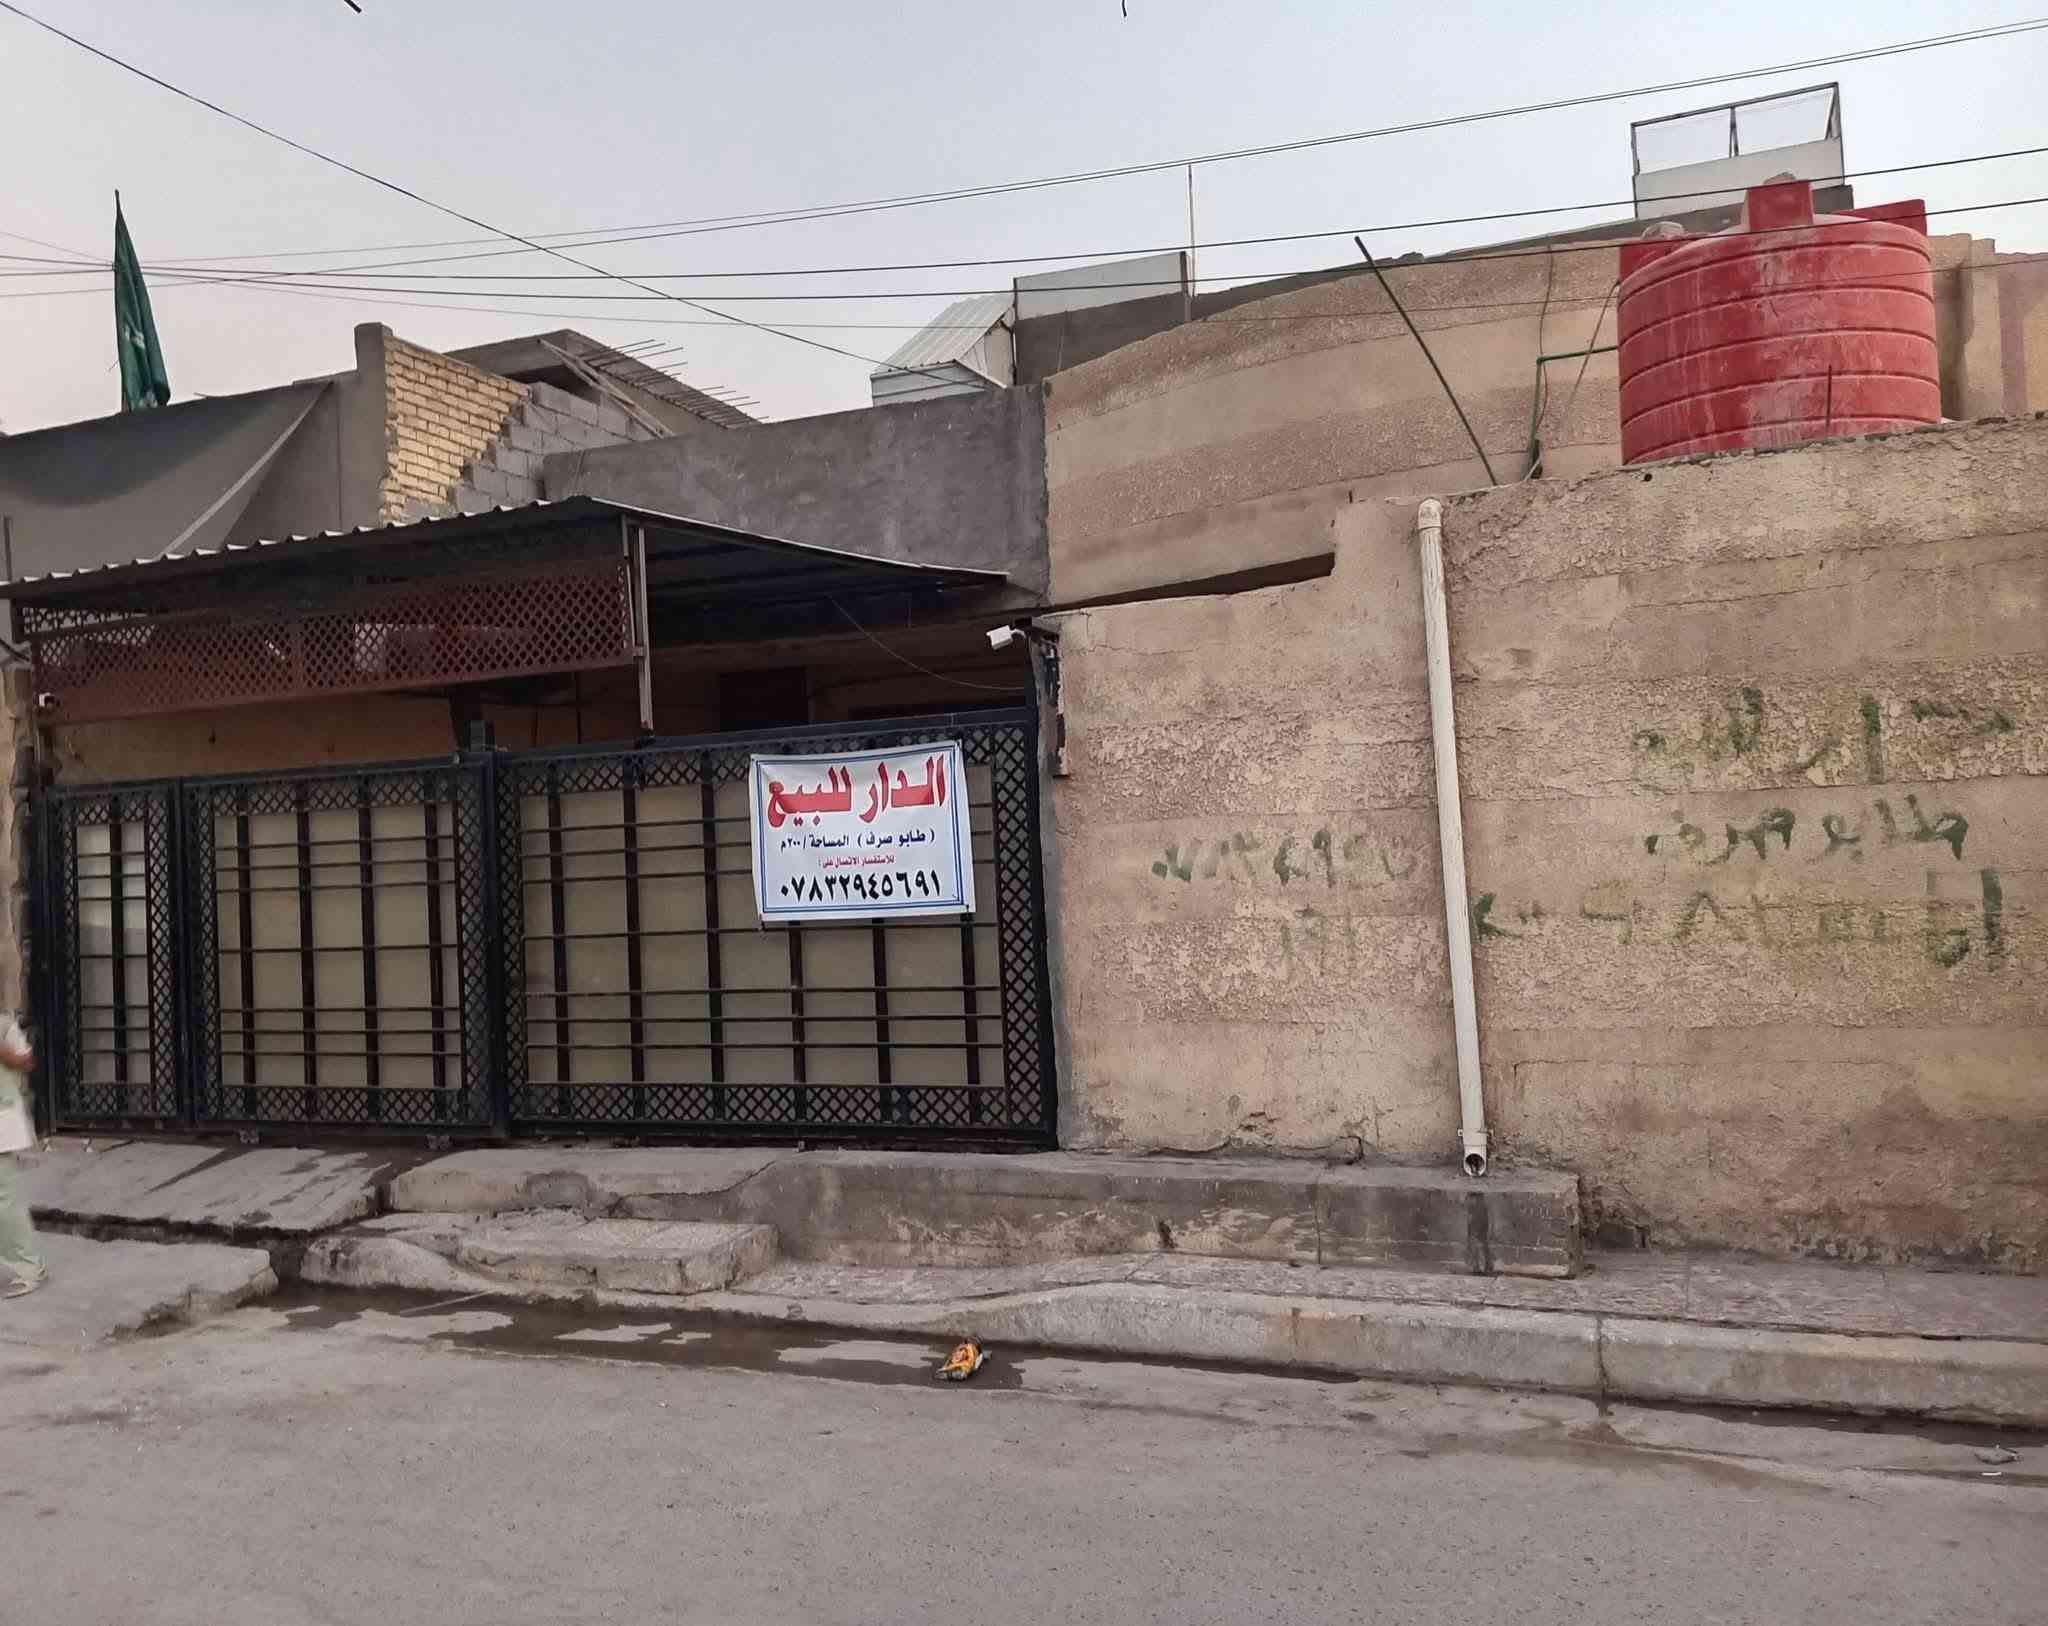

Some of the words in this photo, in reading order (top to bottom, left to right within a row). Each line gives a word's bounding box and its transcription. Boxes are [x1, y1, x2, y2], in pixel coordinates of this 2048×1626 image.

[767, 764, 852, 828] للبيع
[859, 753, 947, 824] الدار
[834, 856, 860, 869] الاتصال
[862, 854, 895, 867] للاستفسار
[781, 869, 941, 902] ٠٧٨٣٢٩٤٥٦٩١
